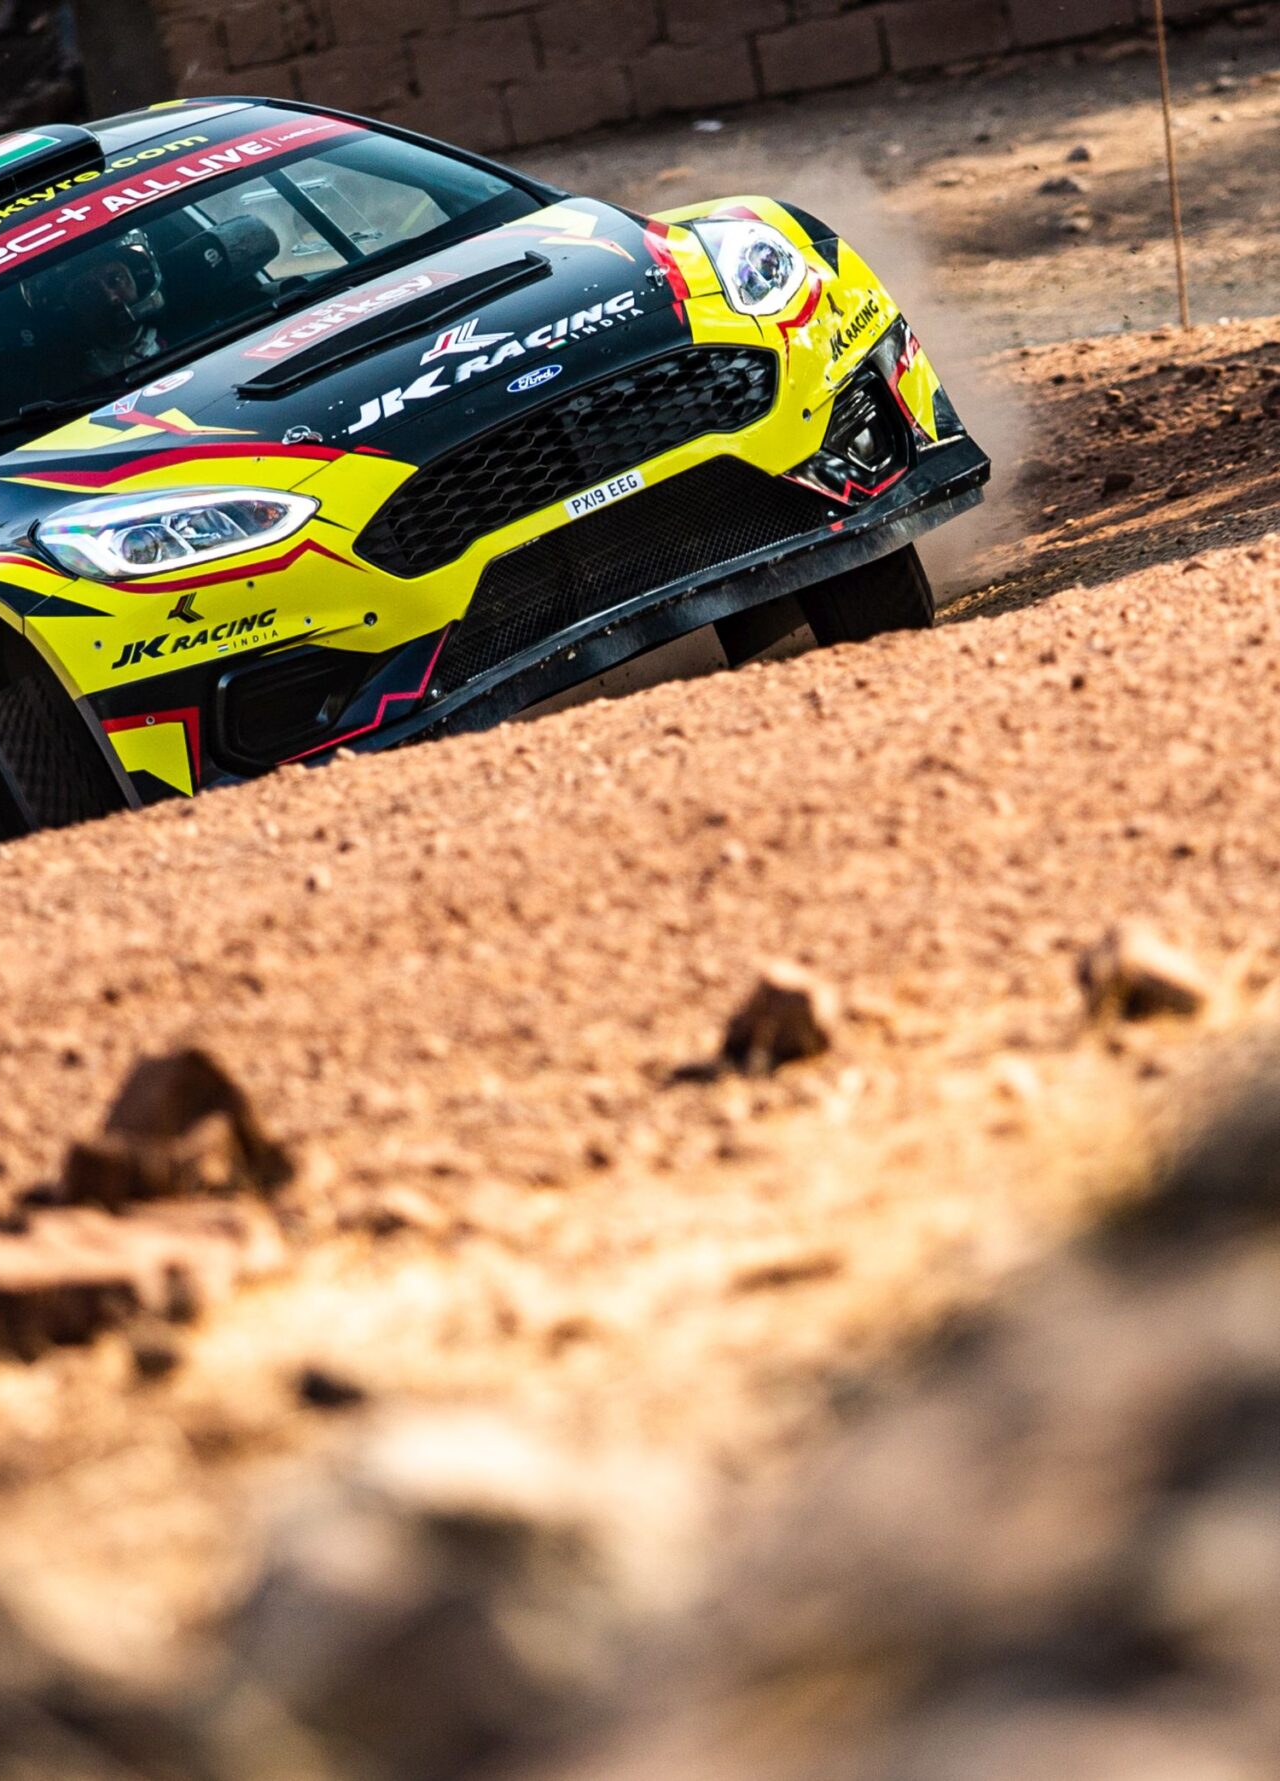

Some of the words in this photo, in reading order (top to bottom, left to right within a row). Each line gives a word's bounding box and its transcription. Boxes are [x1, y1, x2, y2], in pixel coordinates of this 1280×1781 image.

[100, 178, 182, 213] ALL
[176, 140, 273, 178] LIVE
[570, 307, 645, 341] INDIA
[829, 328, 850, 362] JK
[845, 299, 880, 342] RACING
[347, 365, 451, 435] JK
[453, 289, 636, 384] RACING
[571, 488, 606, 514] PX19
[608, 474, 638, 498] EEG
[111, 633, 171, 670] JK
[169, 608, 277, 654] RACING
[233, 629, 279, 649] INDIA
